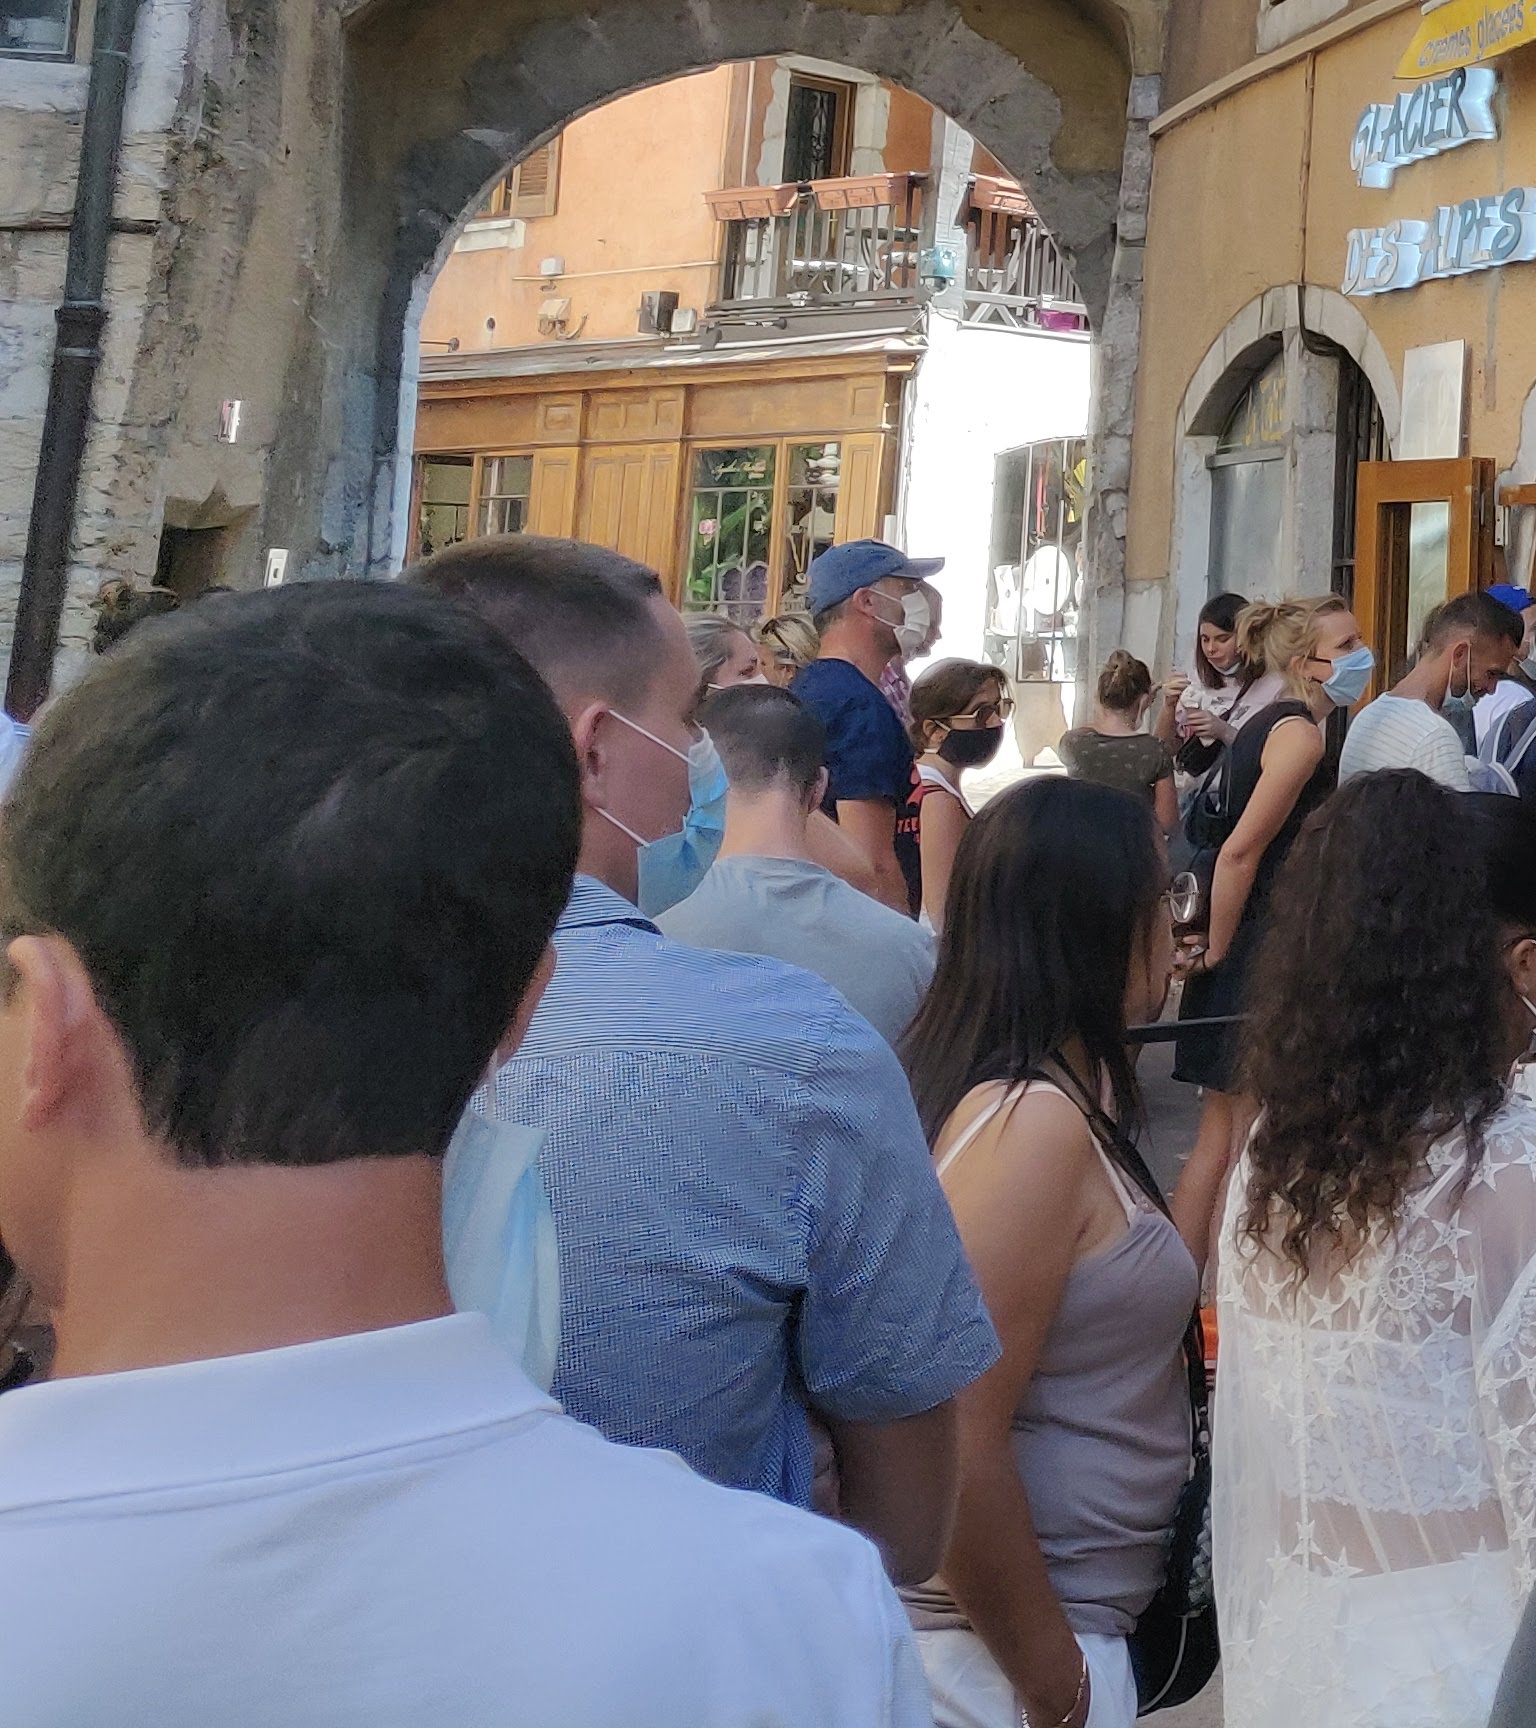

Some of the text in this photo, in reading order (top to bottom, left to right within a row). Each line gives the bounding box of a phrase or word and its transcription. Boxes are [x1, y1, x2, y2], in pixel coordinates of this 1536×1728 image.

[1351, 67, 1471, 187] GLACIER
[1341, 187, 1526, 295] DES ALPES
